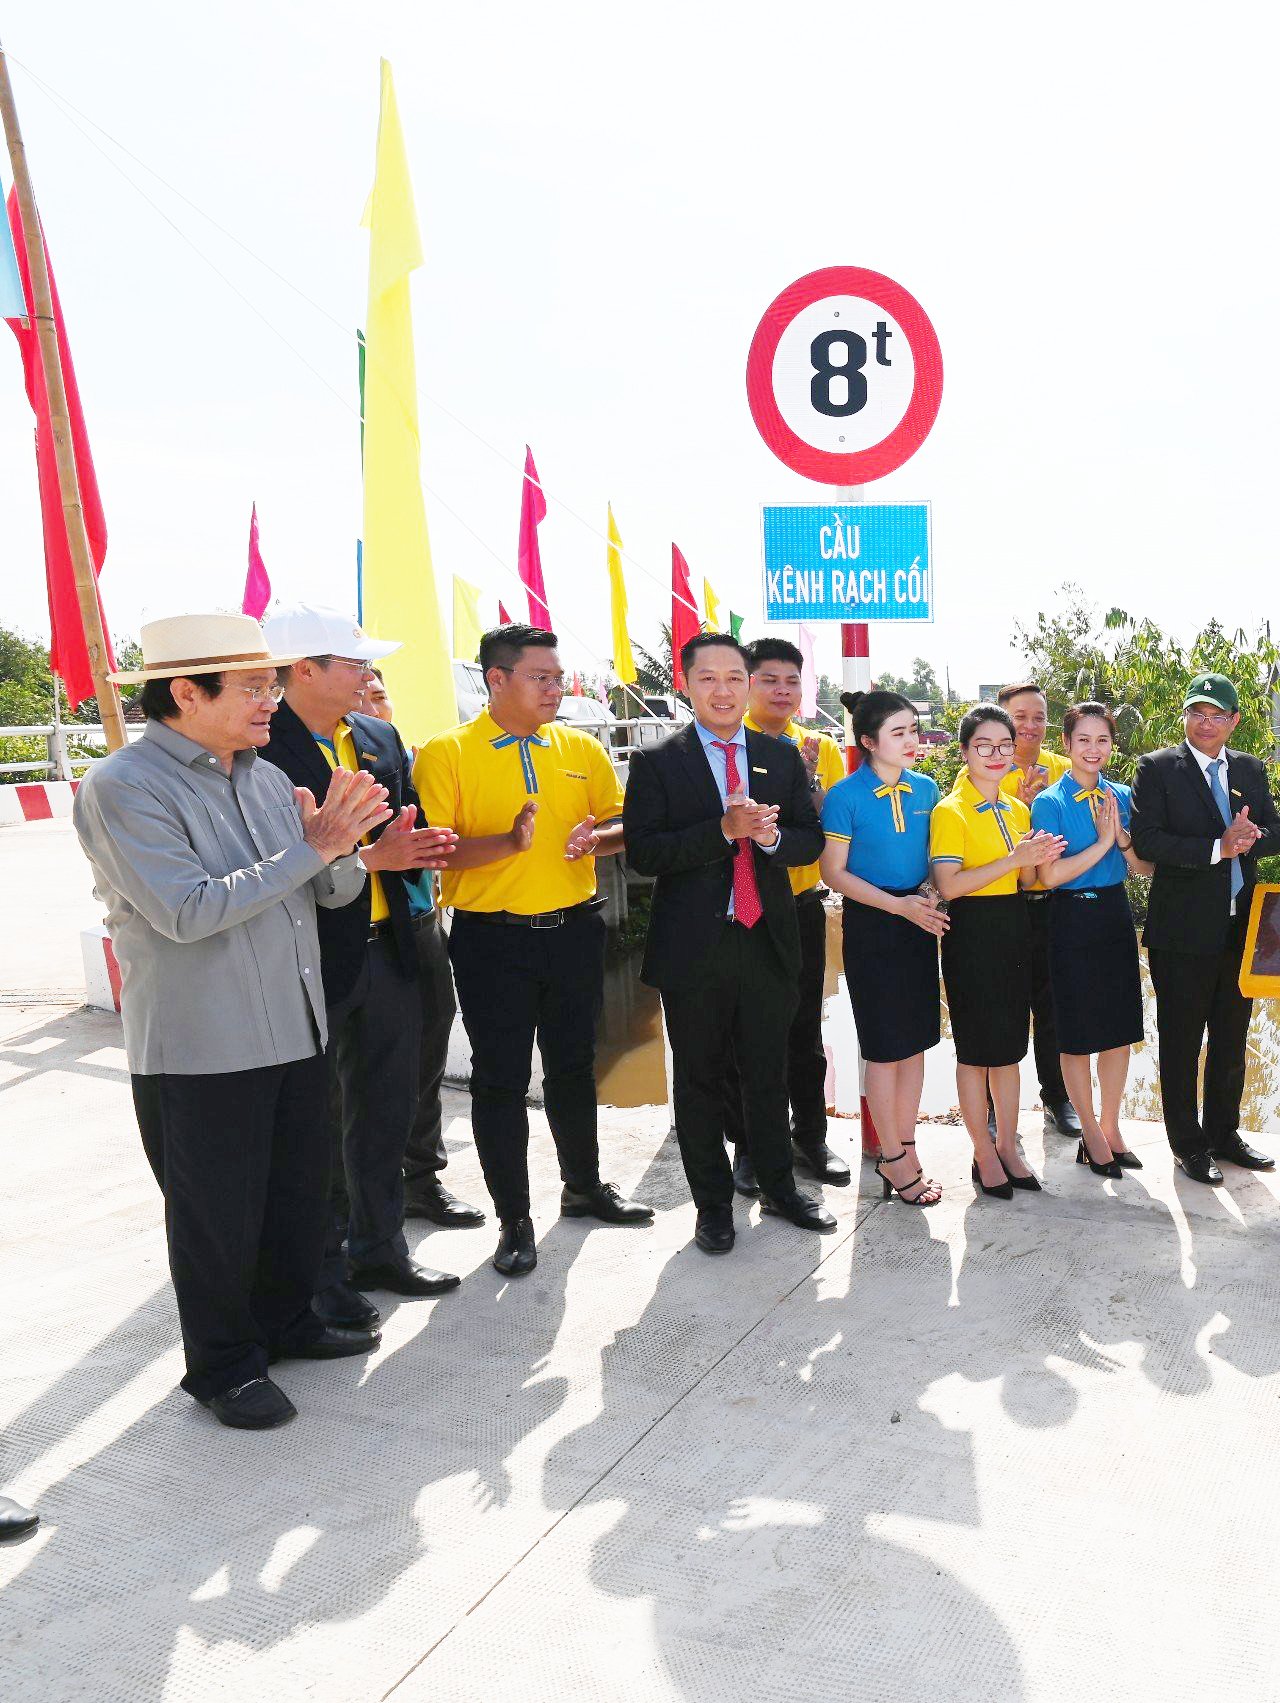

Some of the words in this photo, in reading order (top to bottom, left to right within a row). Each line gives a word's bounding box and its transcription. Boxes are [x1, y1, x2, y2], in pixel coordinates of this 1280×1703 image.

[819, 513, 861, 560] CẦU
[767, 564, 824, 604] KÊNH
[893, 555, 928, 604] CỐI
